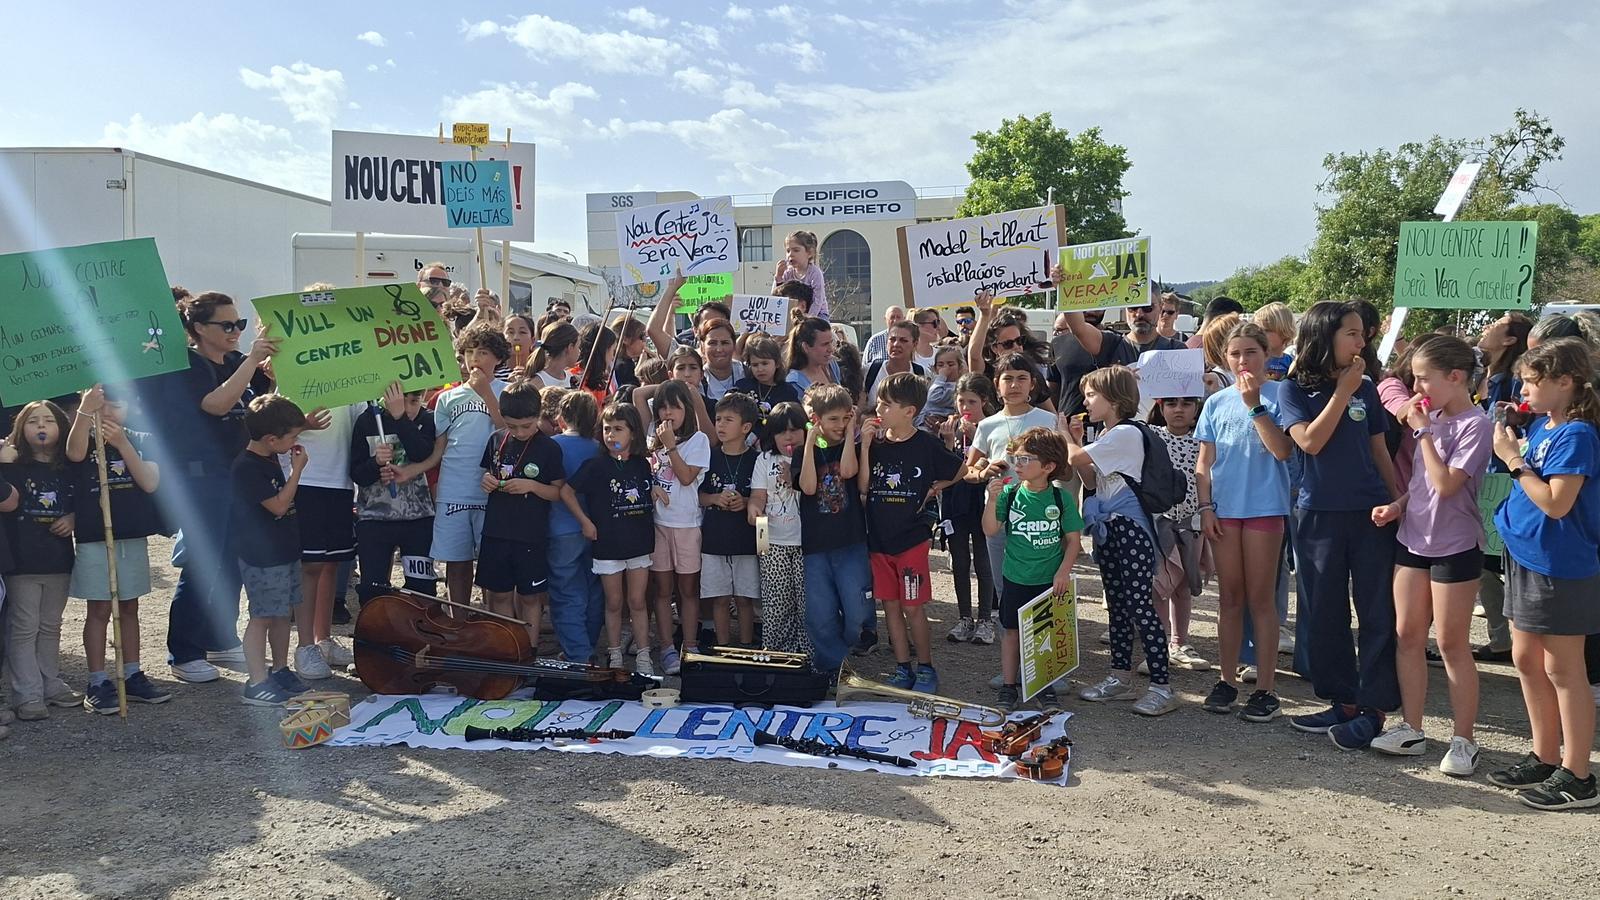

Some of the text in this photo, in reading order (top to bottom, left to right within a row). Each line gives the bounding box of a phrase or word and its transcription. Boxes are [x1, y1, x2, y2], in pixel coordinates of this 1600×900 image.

[450, 161, 477, 183] NO
[482, 184, 506, 203] MÁS
[611, 195, 634, 208] SGS
[804, 188, 879, 201] EDIFICIO
[450, 207, 510, 226] VUELTAS
[786, 203, 901, 217] SON PERETO
[654, 209, 697, 237] Centre
[919, 214, 1049, 260] Model brillant
[1405, 227, 1436, 257] NOU
[1440, 227, 1485, 258] CENTRE
[1073, 240, 1140, 260] NOU CENTRE
[1111, 252, 1146, 280] JA!
[1063, 281, 1119, 298] VERA?
[1401, 267, 1428, 298] Serà
[1434, 267, 1460, 299] Vera
[748, 296, 769, 310] NOU
[273, 305, 375, 338] VULL UN
[739, 309, 782, 323] CENTRE
[295, 339, 364, 366] CENTRE
[1023, 614, 1036, 684] NOU CENTRE
